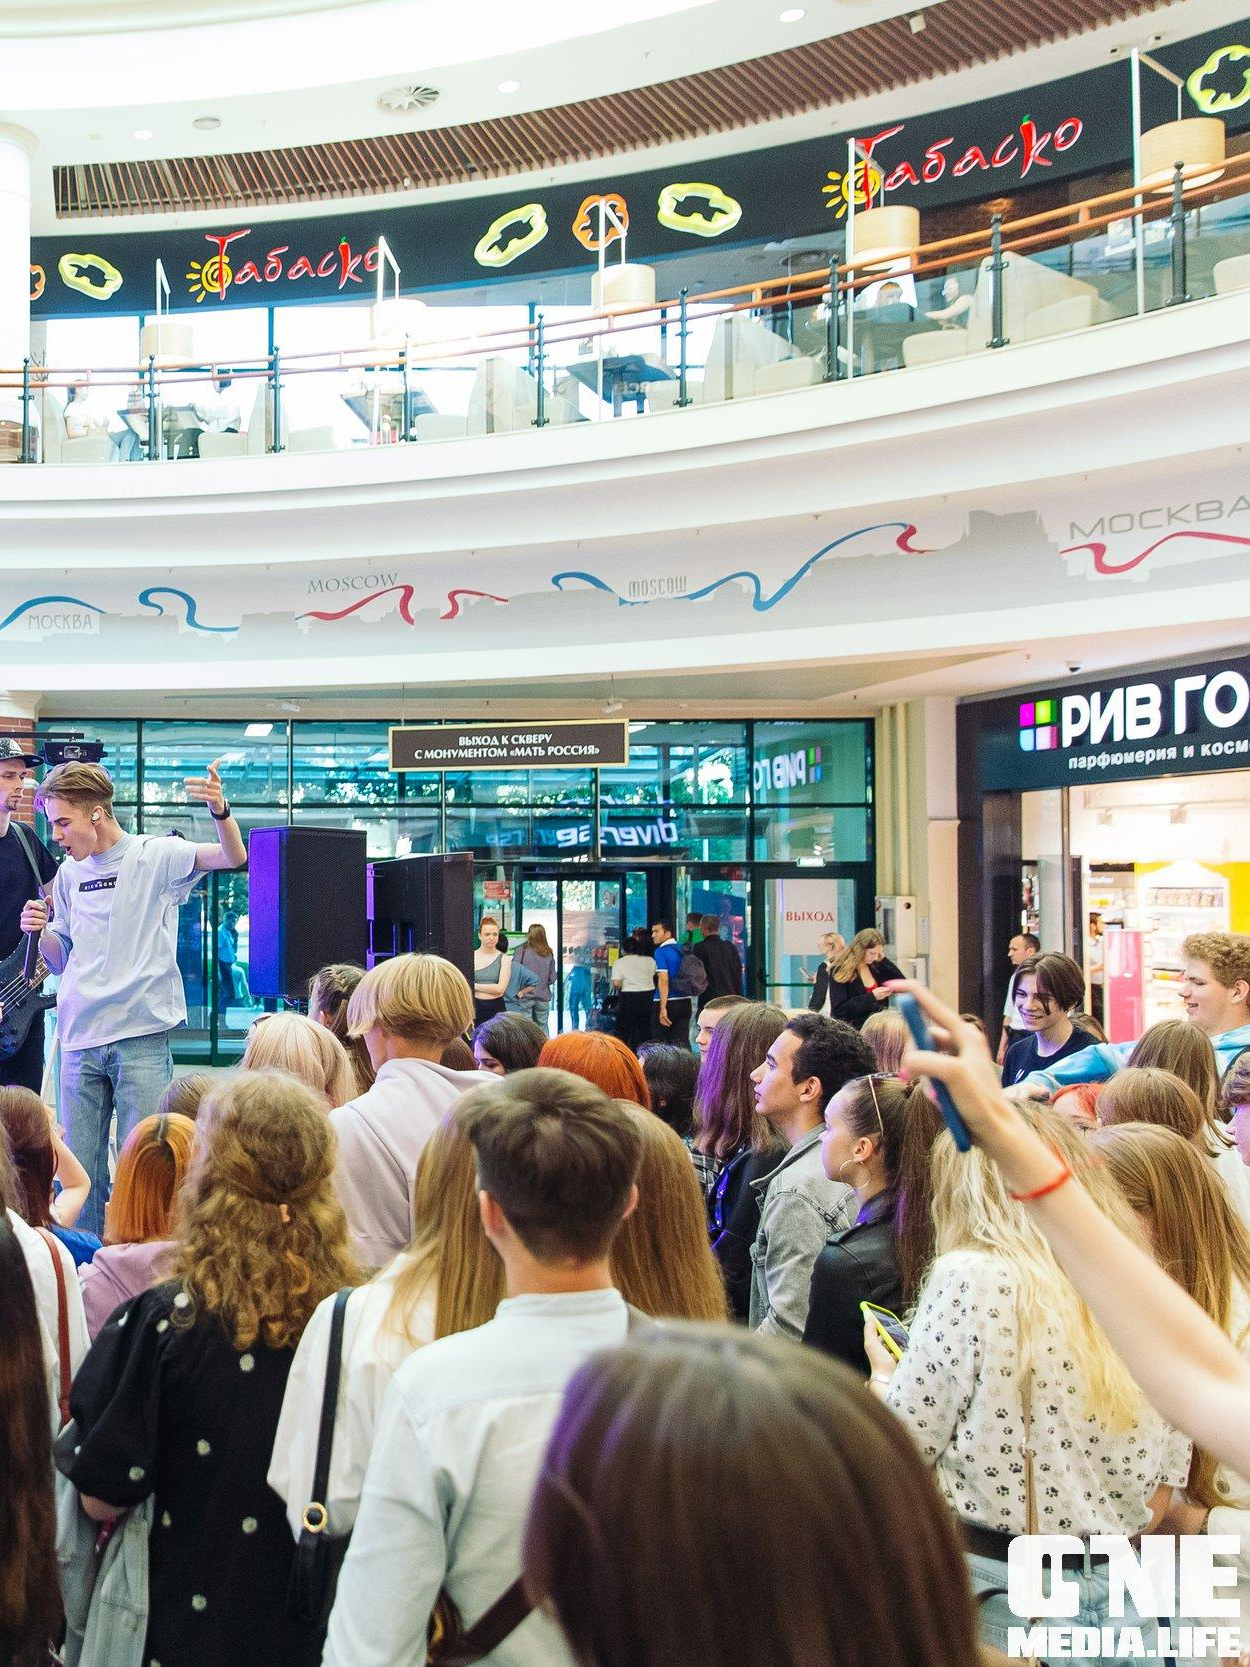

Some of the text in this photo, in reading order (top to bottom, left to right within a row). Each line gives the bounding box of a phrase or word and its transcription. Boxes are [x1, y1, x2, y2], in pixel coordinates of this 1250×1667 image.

[846, 114, 1083, 211] Табаско
[1069, 495, 1250, 540] МОСКВА
[307, 572, 398, 593] MOSCOW
[27, 613, 93, 630] МОСКВА
[1061, 670, 1250, 748] РИВ ГО
[458, 733, 553, 747] ВЫХОД К СКВЕРУ
[414, 745, 600, 760] С МОНУМЕНТОМ «МАТЬ РОССИЯ»
[1068, 739, 1250, 771] парфюмерия и косм
[785, 911, 835, 922] ВЫХОД
